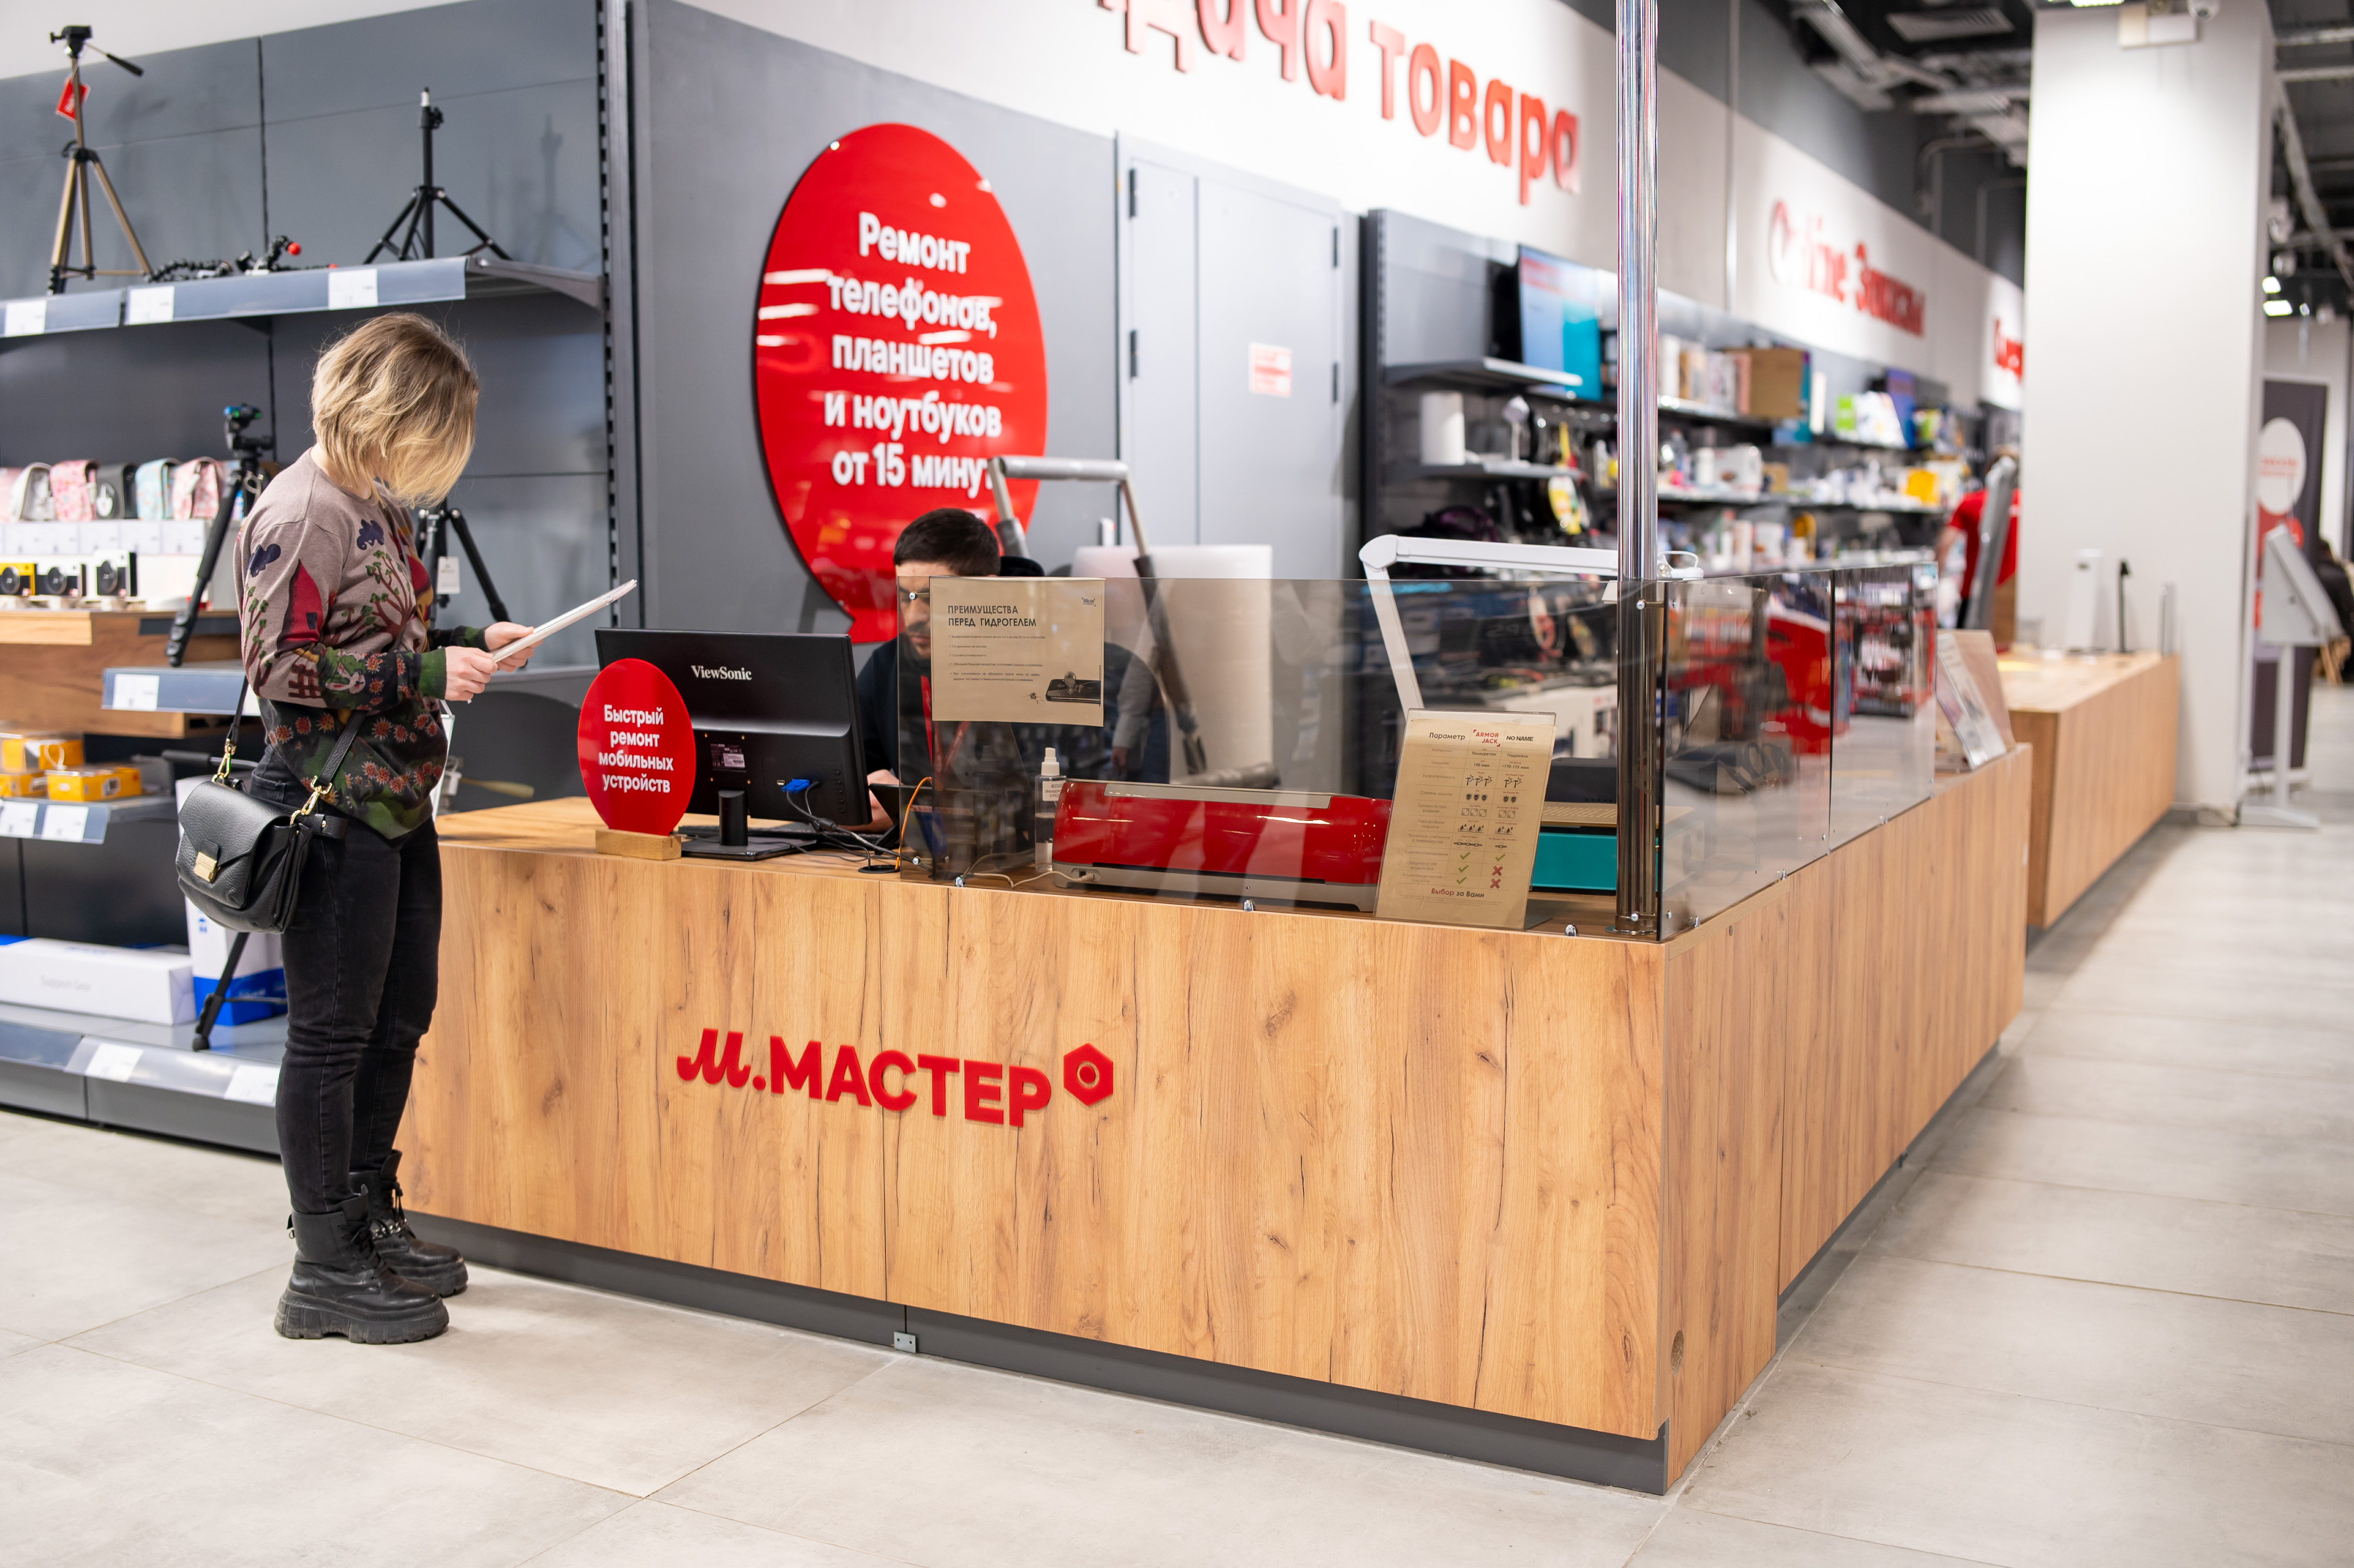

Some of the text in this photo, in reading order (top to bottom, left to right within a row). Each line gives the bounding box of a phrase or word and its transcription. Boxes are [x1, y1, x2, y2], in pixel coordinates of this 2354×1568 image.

[1097, 0, 1581, 206] дача товара
[858, 211, 971, 274] Ремонт
[826, 276, 998, 338] телефонов,
[832, 335, 995, 385] планшетов
[825, 390, 1002, 444] и ноутбуков
[832, 450, 869, 486] от
[871, 442, 906, 487] 15
[948, 605, 1018, 615] ПРЕИМУЩЕСТВА
[948, 618, 1037, 627] ПЕРЕД ГИДРОГЕЛЕМ
[691, 664, 752, 681] ViewSonic
[604, 704, 664, 726] Быстрый
[610, 727, 660, 748] ремонт
[1429, 732, 1465, 741] Параметр
[599, 752, 674, 771] мобильных
[603, 773, 671, 794] устройств
[1431, 887, 1455, 897] Выбор
